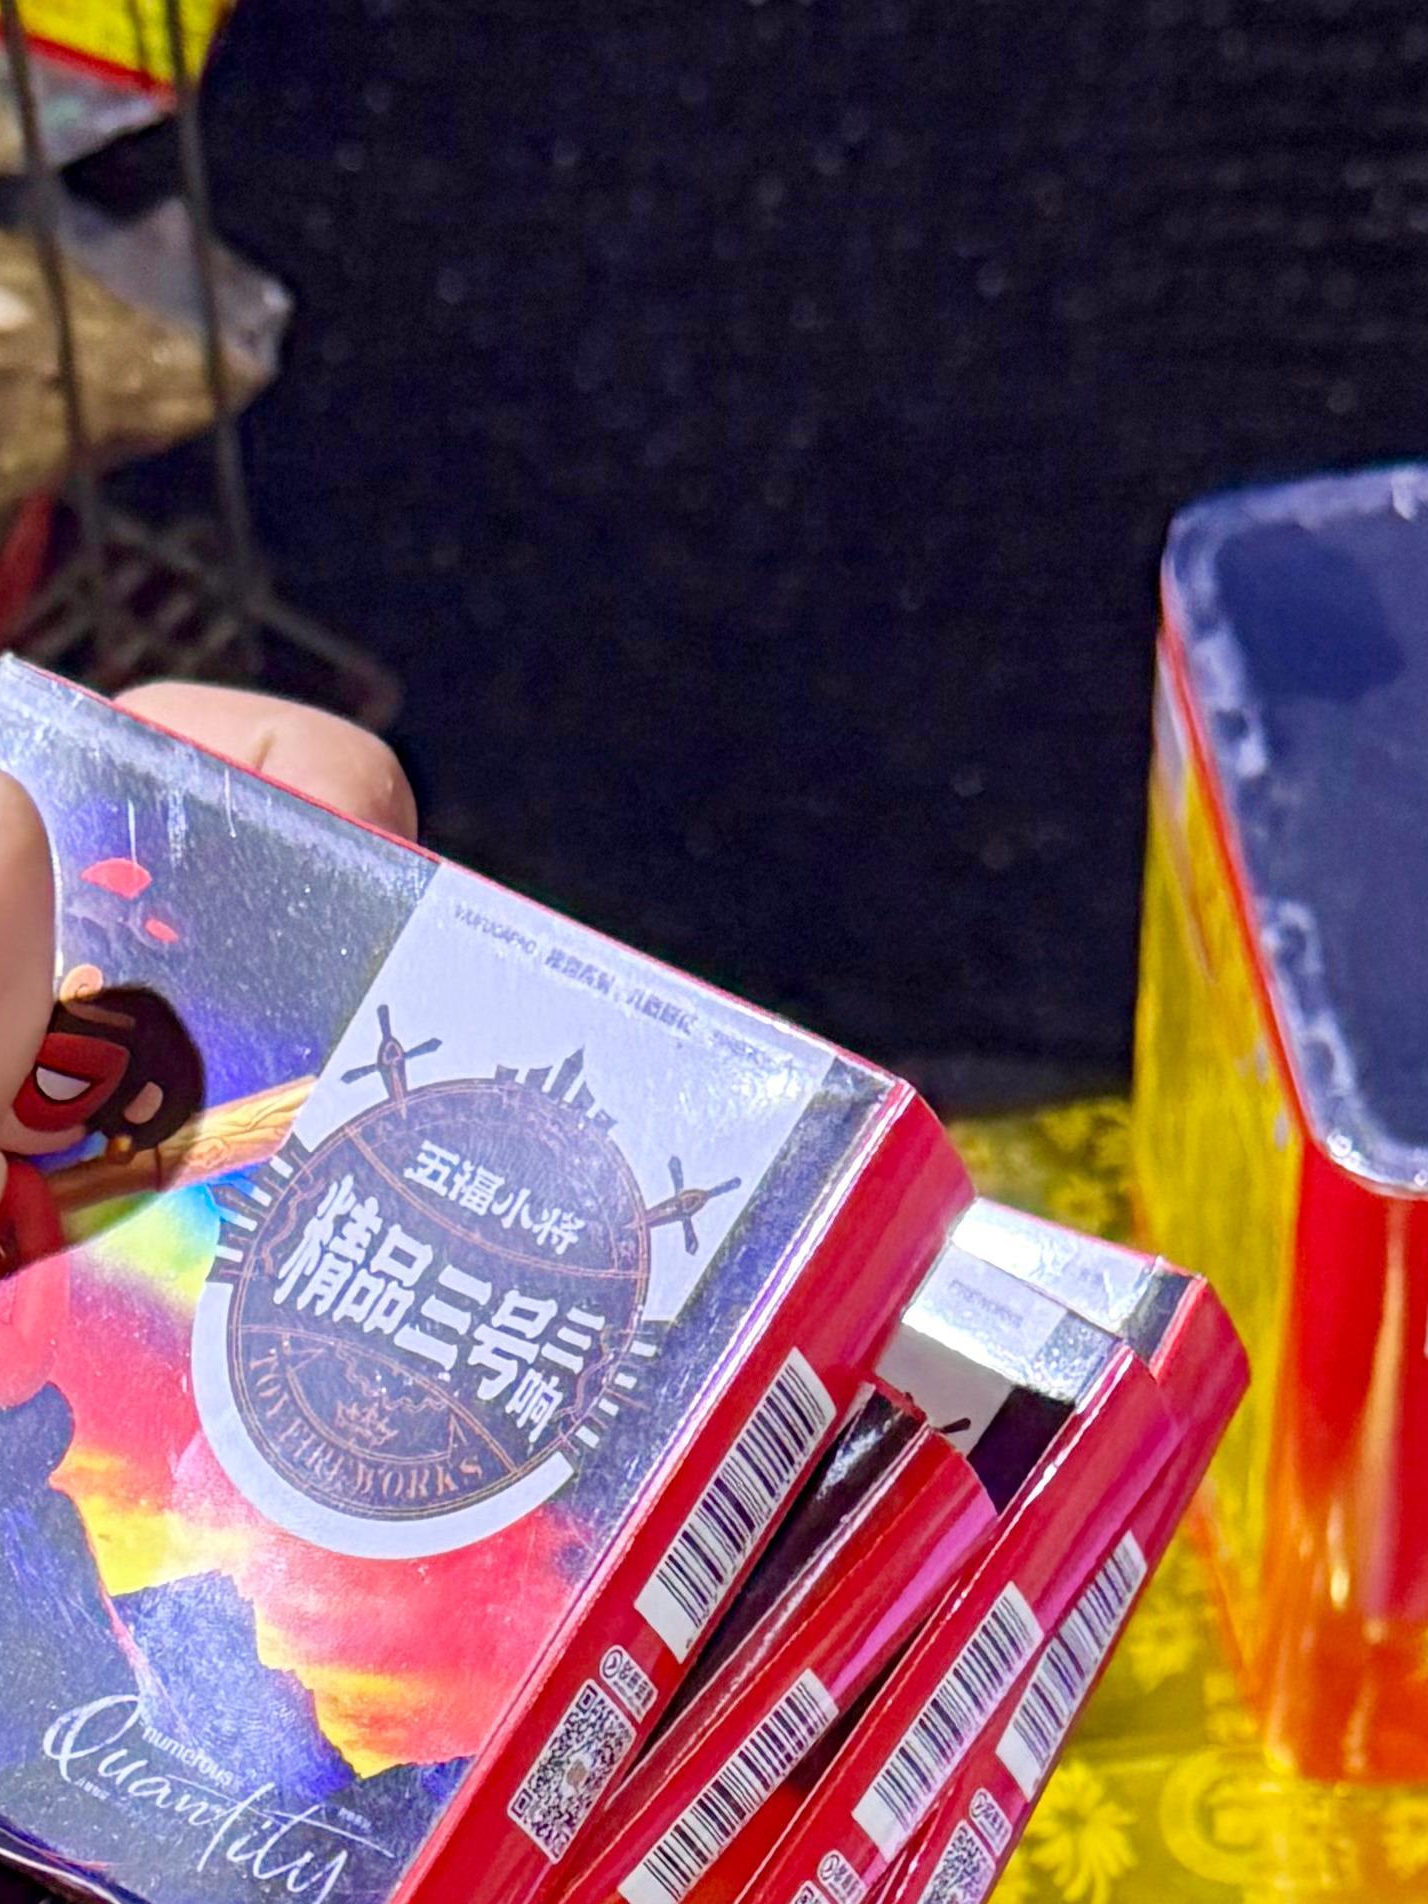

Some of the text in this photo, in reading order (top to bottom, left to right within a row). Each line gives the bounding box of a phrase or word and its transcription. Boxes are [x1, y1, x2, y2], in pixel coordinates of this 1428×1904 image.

[404, 1140, 586, 1256] 五福小将
[271, 1173, 564, 1402] 精品三号
[246, 1340, 484, 1503] TOY FIREWORKS
[506, 1303, 606, 1445] 三响
[144, 1722, 236, 1788] numerous
